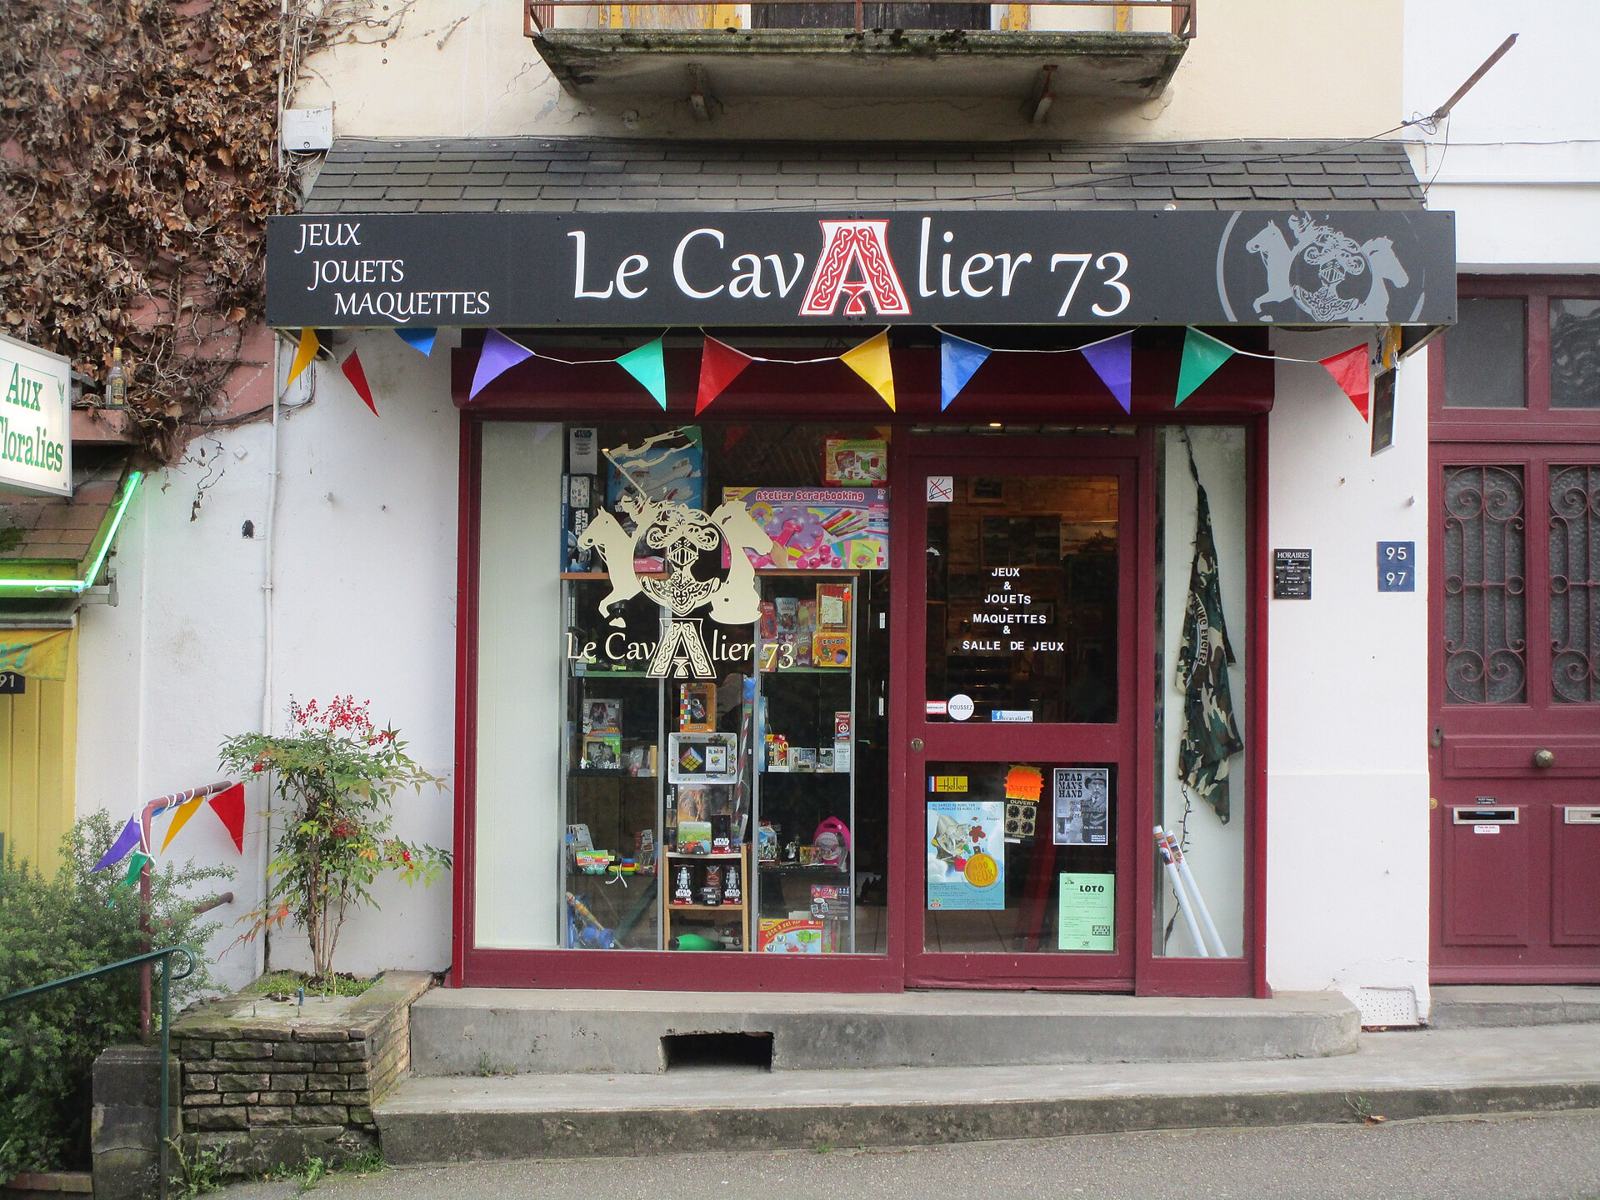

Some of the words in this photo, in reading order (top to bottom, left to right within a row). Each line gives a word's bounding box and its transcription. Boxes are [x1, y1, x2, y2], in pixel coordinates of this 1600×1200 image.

[294, 223, 361, 254] JEUX
[566, 230, 649, 300] Le
[672, 216, 1032, 316] CavAlier
[1050, 252, 1131, 317] 73
[307, 259, 404, 291] JOUETS
[334, 291, 490, 323] MAQUETTES
[6, 362, 43, 412] Aux
[756, 490, 793, 501] Atelier
[795, 490, 864, 502] Scrapbooking
[1277, 551, 1310, 559] HORAIRES
[1385, 547, 1407, 560] 95
[991, 567, 1020, 577] JEUX
[1385, 572, 1407, 586] 97
[1003, 581, 1011, 590] &
[984, 593, 1032, 605] JOUETS
[972, 613, 1047, 624] MAQUETTES
[1003, 625, 1011, 635] &
[566, 632, 597, 660] Le
[605, 618, 757, 679] CavAlier
[762, 643, 794, 669] 73
[962, 640, 1001, 650] SALLE
[1010, 641, 1025, 651] DE
[1032, 641, 1065, 652] JEUX
[1058, 773, 1083, 782] DEAD
[1058, 782, 1083, 790] MAN'S
[1058, 790, 1083, 798] HAND
[1079, 885, 1105, 893] LOTO
